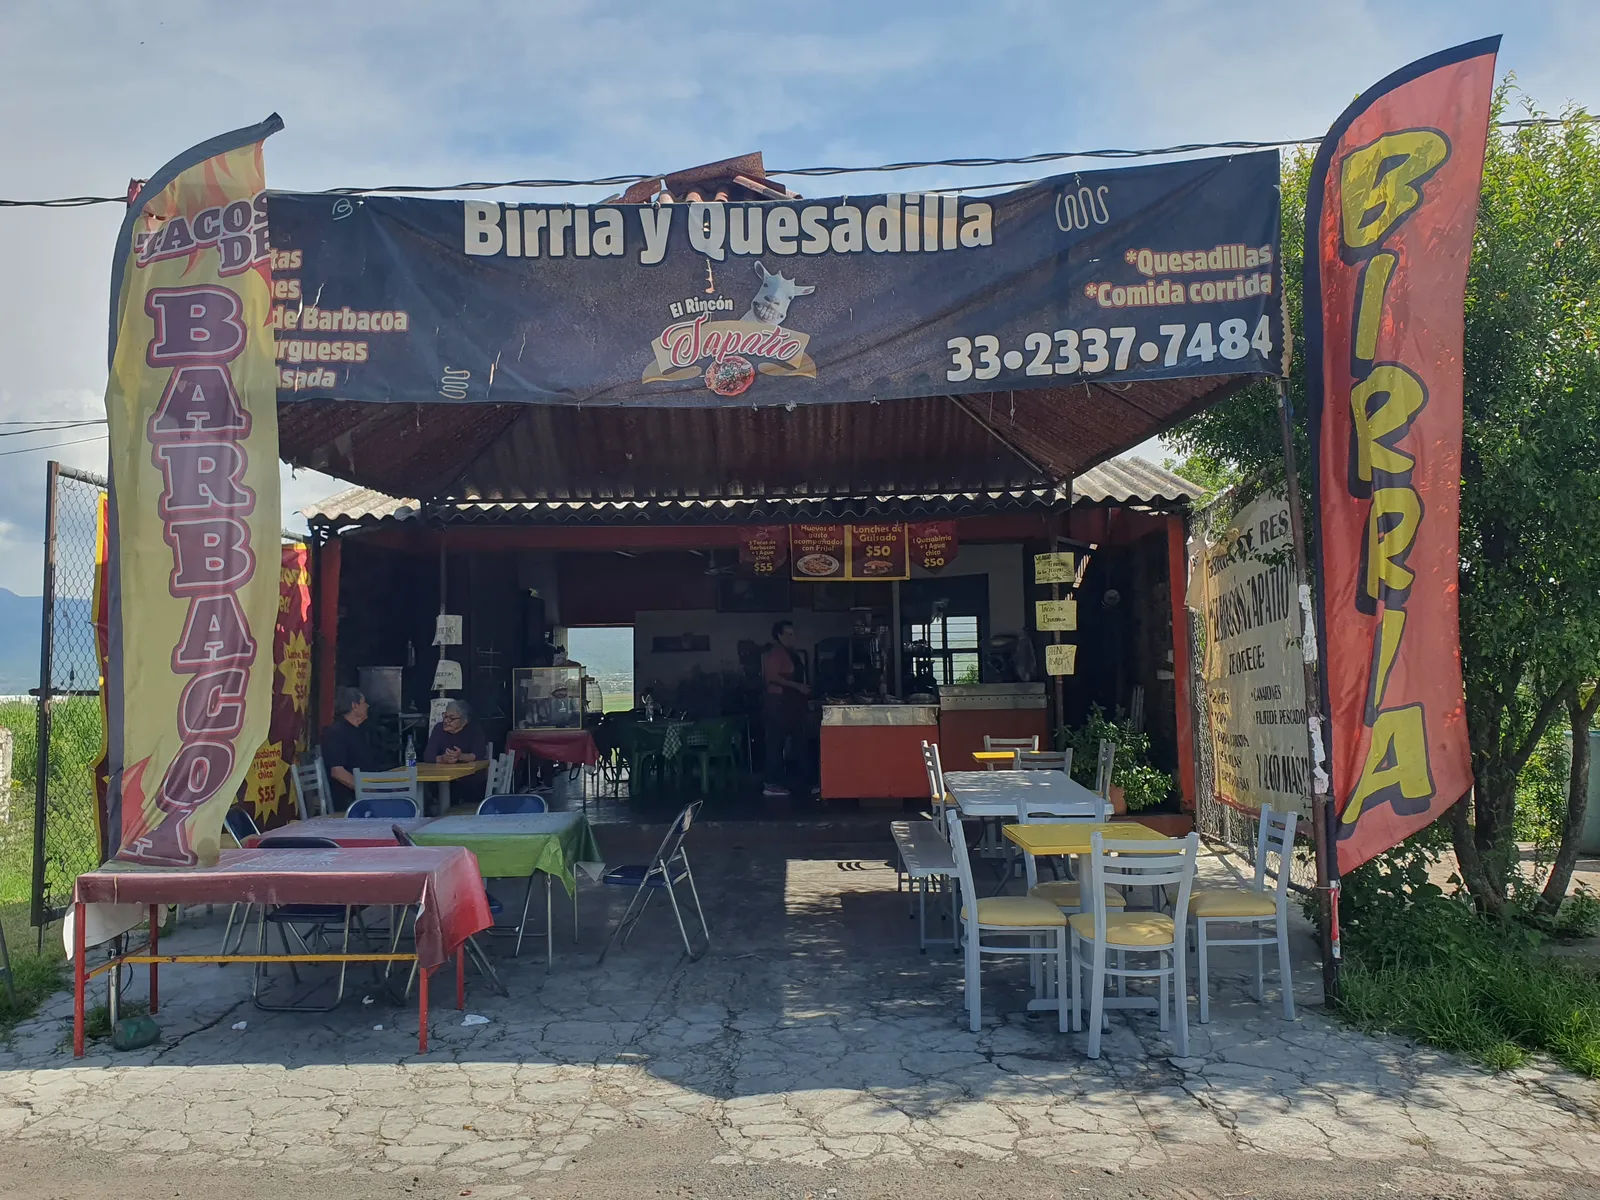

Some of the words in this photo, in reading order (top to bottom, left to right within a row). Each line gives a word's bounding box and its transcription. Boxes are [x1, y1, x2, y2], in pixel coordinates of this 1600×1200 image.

[134, 191, 268, 267] TACOS
[464, 200, 624, 257] Birria
[640, 207, 672, 265] y
[688, 194, 993, 261] Quesadilla
[1190, 273, 1273, 304] corrida
[272, 306, 298, 330] de
[302, 307, 408, 331] Barbacoa
[670, 303, 684, 319] El
[684, 295, 734, 314] Rincón
[1339, 128, 1449, 836] BIRRIA
[853, 525, 890, 534] Lonches
[859, 532, 897, 542] Guisado
[1260, 509, 1289, 546] RES
[865, 545, 891, 557] $50
[923, 556, 945, 568] $50
[754, 562, 773, 572] $55
[258, 784, 276, 805] $55
